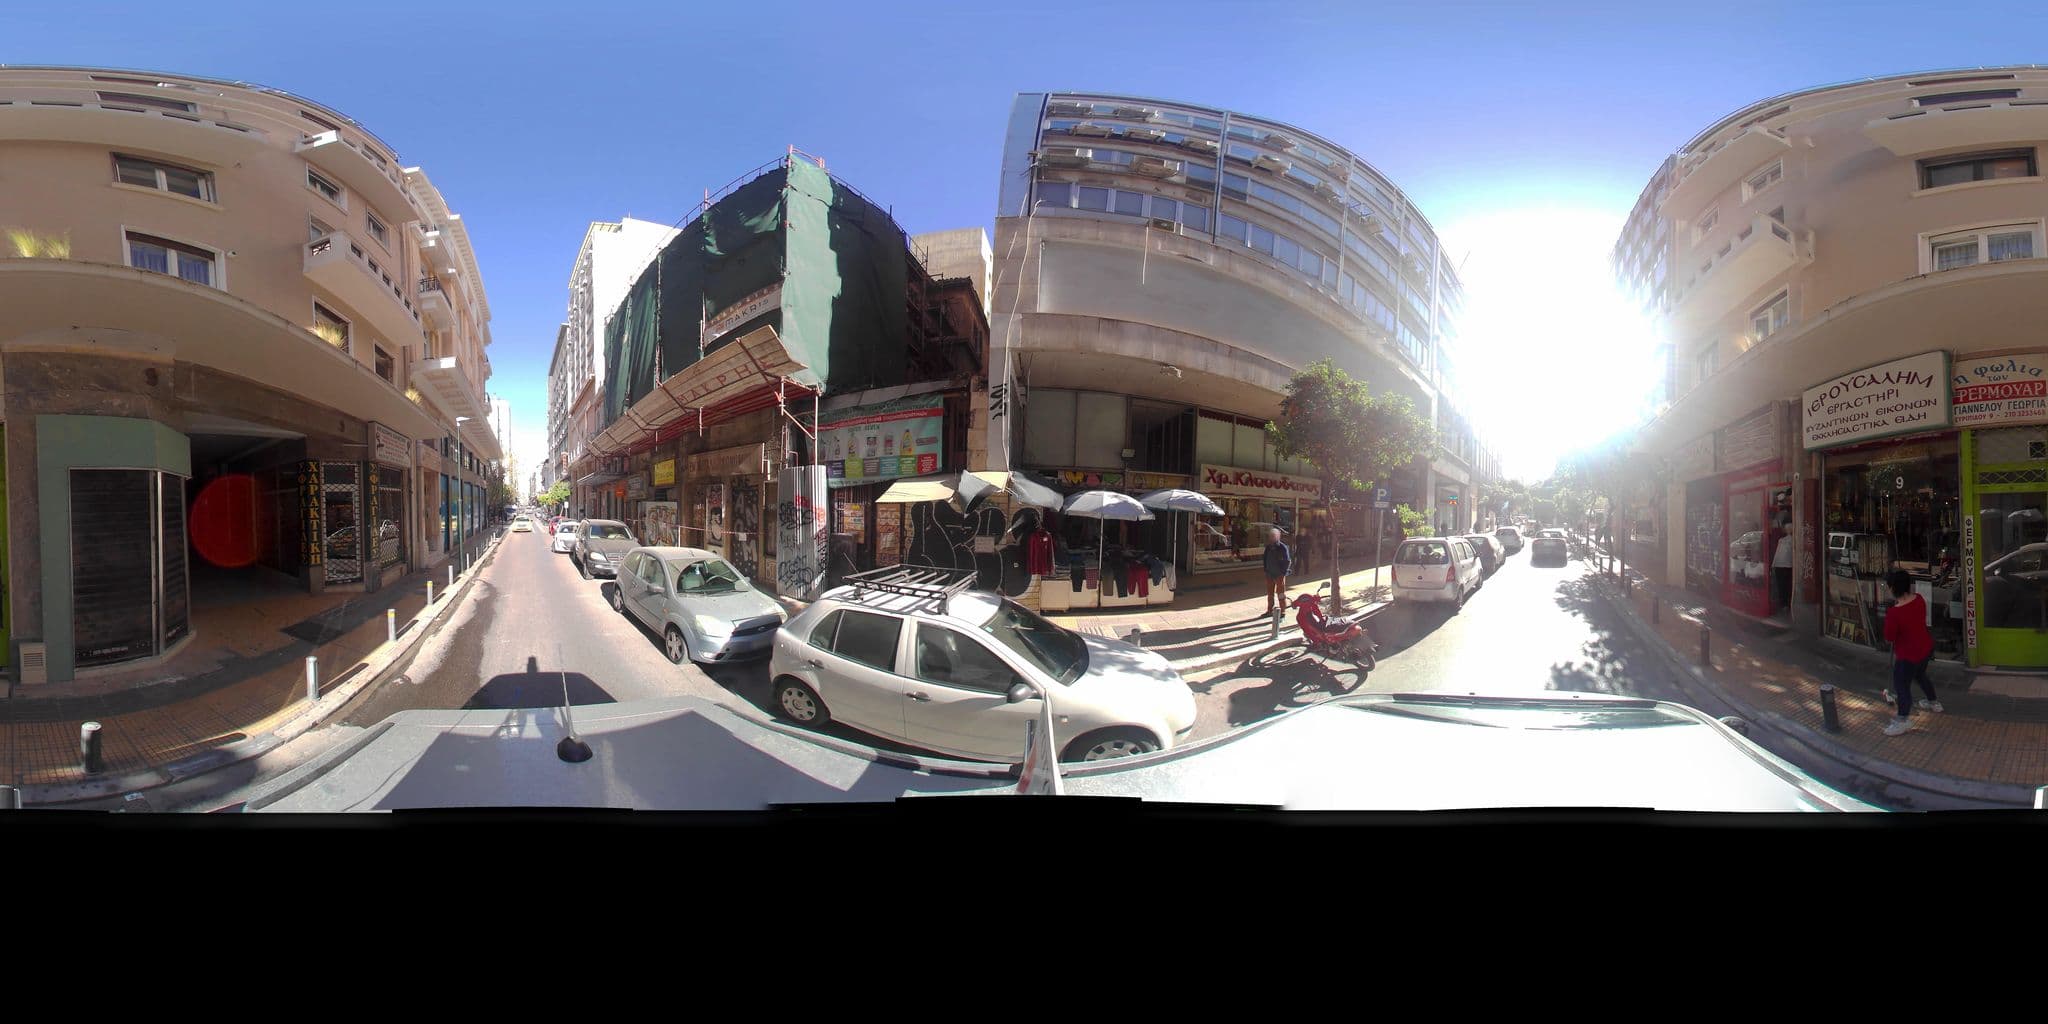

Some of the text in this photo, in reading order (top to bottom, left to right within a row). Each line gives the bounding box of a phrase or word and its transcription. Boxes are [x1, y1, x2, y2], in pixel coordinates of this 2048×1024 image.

[1807, 371, 1934, 417] ΙΕΡΟΥΣΑΛΗΜ
[1827, 388, 1899, 415] ΕΡΓΑΣΤΗΡΙ
[1876, 398, 1937, 416] ΕΙΚΟΝΩΝ
[1954, 400, 2046, 415] ΓΙΑΝΝΕΛΟΥ ΓΕΩΡΓΙΑ
[1895, 412, 1927, 424] ΕΙΔΗ
[1377, 488, 1387, 501] P
[1895, 476, 1904, 489] 9
[308, 461, 321, 565] ΧΑΡΑΚΤΙΚΗ
[369, 463, 379, 559] ΣΦΡΑΓΙΔΕΣ
[1965, 518, 1974, 595] ΦΕΡΜΟΥΑΡ
[1967, 600, 1976, 646] ΕΝΤΟΣ
